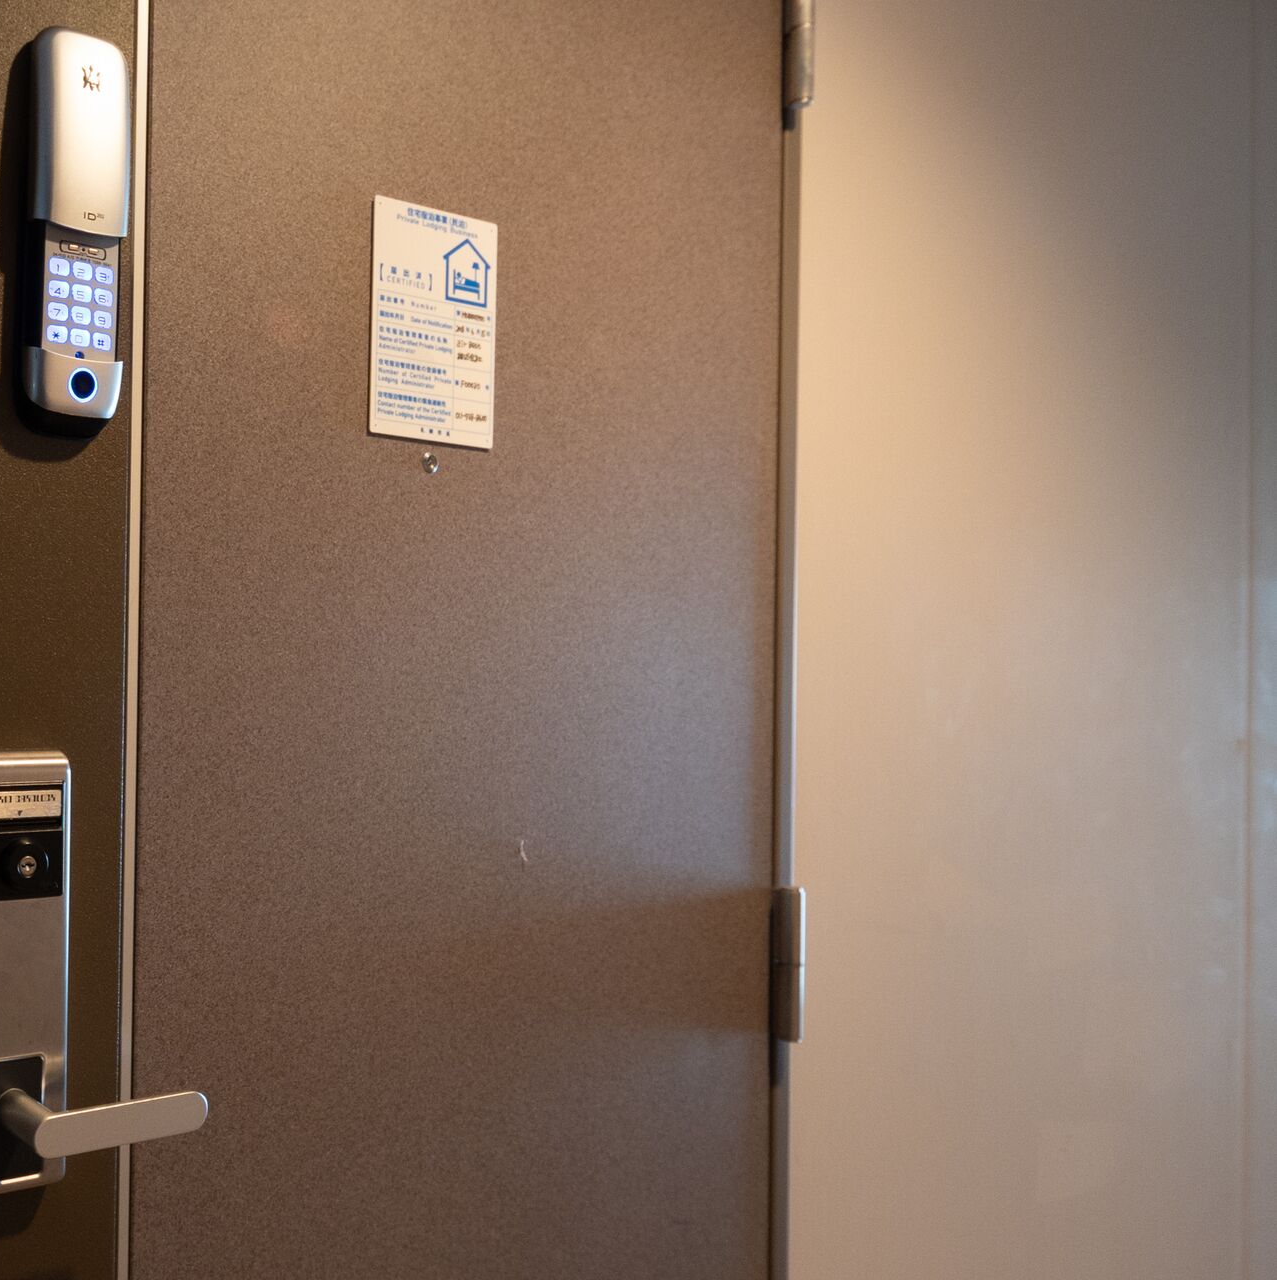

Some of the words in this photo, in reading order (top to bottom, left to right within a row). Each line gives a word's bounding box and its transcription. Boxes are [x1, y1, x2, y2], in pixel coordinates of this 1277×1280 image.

[53, 287, 62, 295] 4
[98, 294, 107, 304] 6
[53, 308, 62, 317] 7
